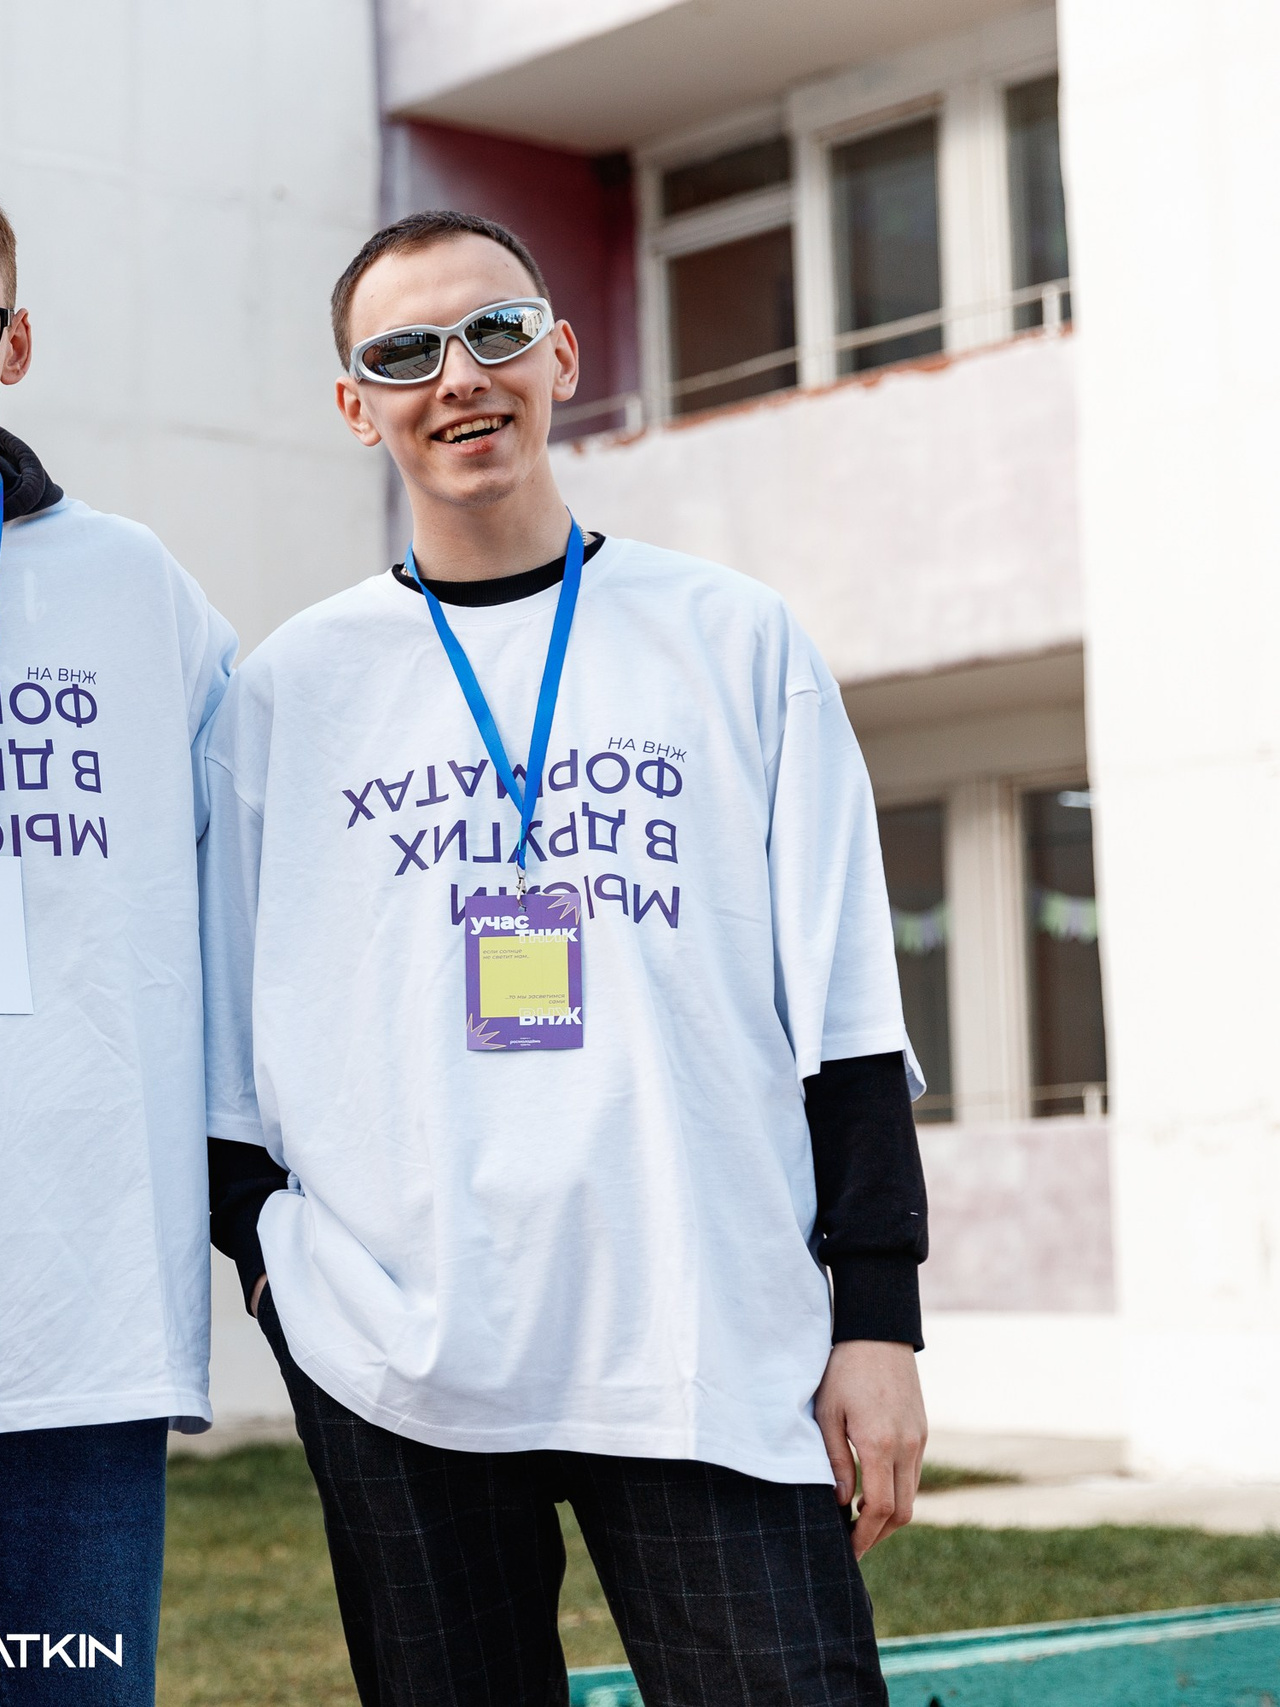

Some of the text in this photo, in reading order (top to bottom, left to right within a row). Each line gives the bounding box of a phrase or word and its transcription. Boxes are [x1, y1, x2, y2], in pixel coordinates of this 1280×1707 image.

[27, 667, 97, 685] НА ВНЖ
[608, 737, 687, 763] НА ВНЖ
[72, 750, 102, 793] В
[645, 819, 679, 864] В
[519, 1007, 583, 1026] ВНЖ
